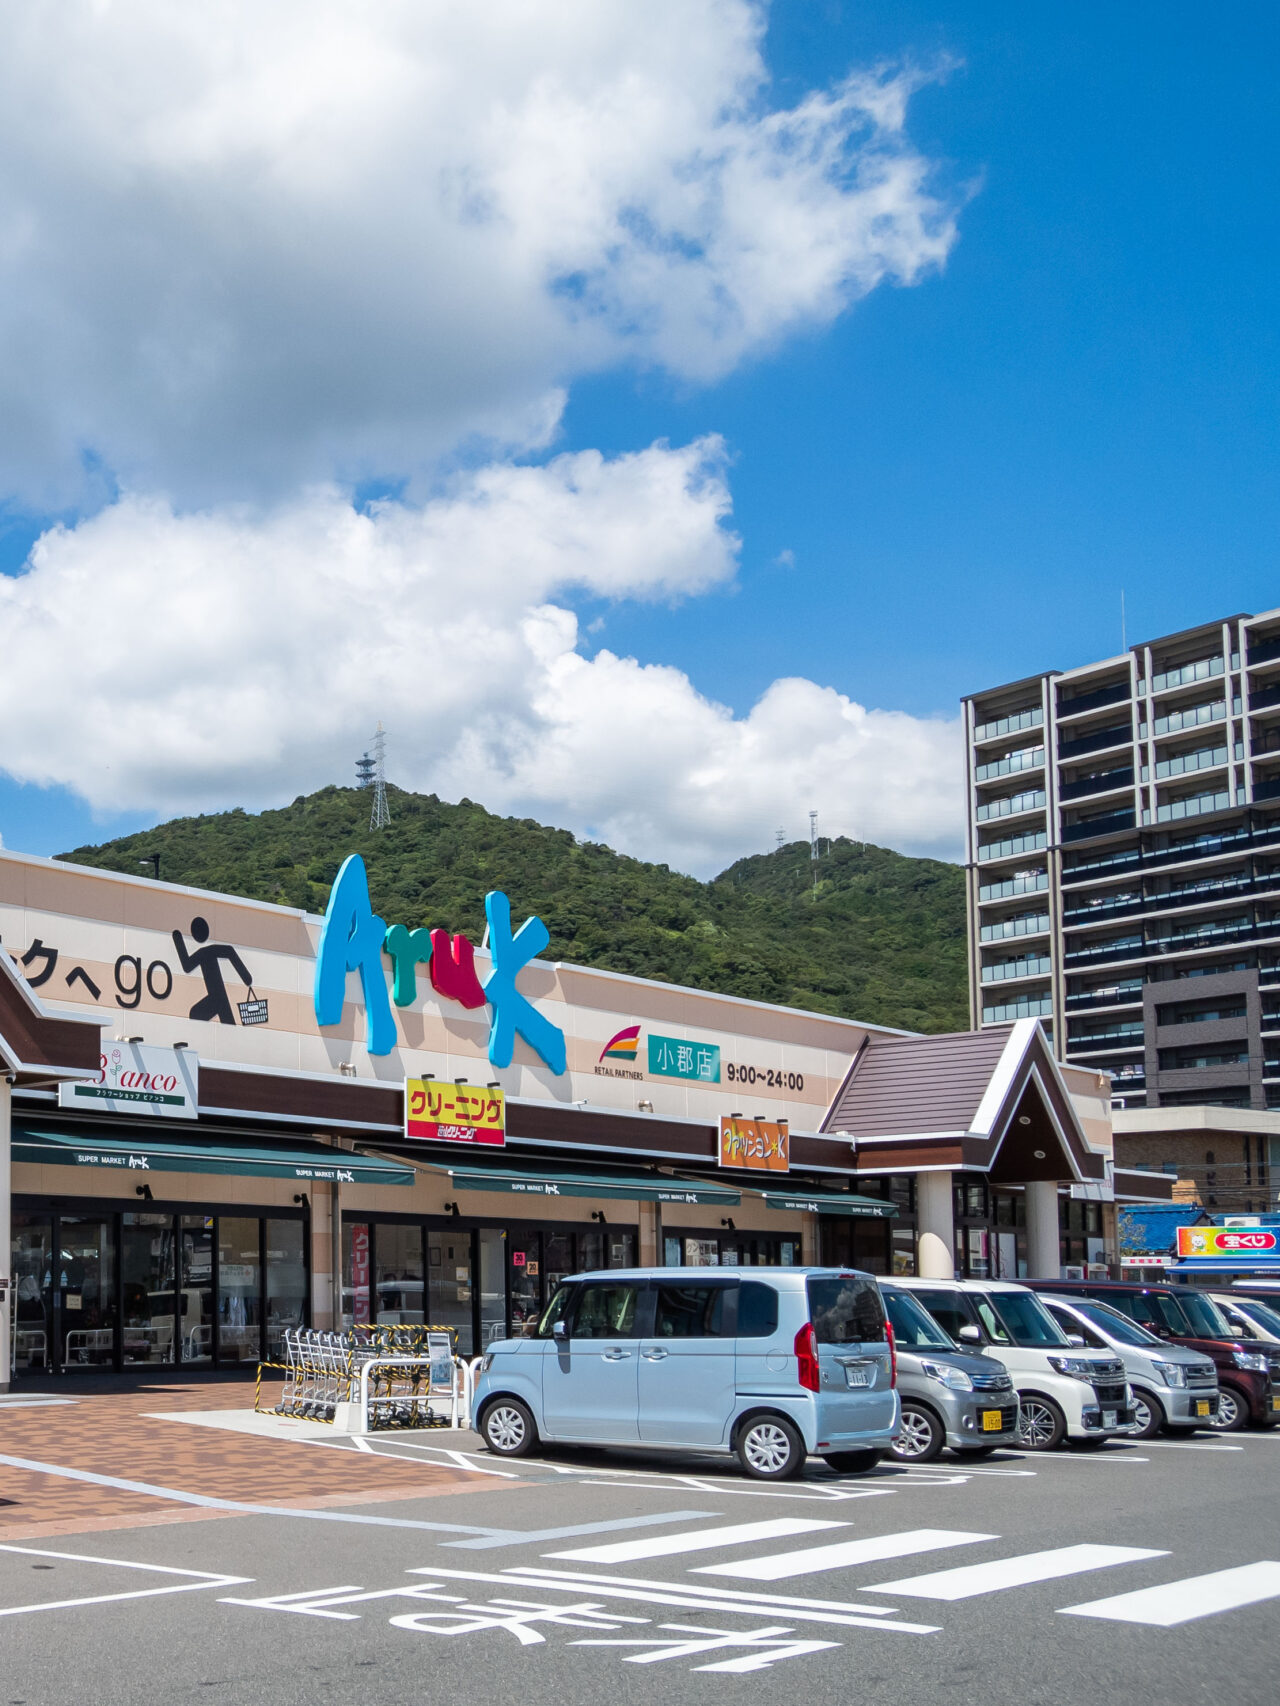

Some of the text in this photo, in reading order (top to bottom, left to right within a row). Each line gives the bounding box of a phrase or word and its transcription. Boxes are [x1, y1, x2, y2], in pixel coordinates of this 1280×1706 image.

[115, 955, 173, 1008] go
[657, 1042, 712, 1077] 小郡店
[594, 1066, 643, 1081] RETAIL PARTNERS
[96, 1089, 164, 1102] フラワーショップ ビアンコ
[411, 1091, 501, 1122] クリーニング
[78, 1155, 98, 1163] SUPER
[101, 1157, 125, 1165] MARKET
[296, 1169, 312, 1177] SUPER
[1224, 1235, 1266, 1247] 宝くじ
[215, 1584, 844, 1674] 止まれ
